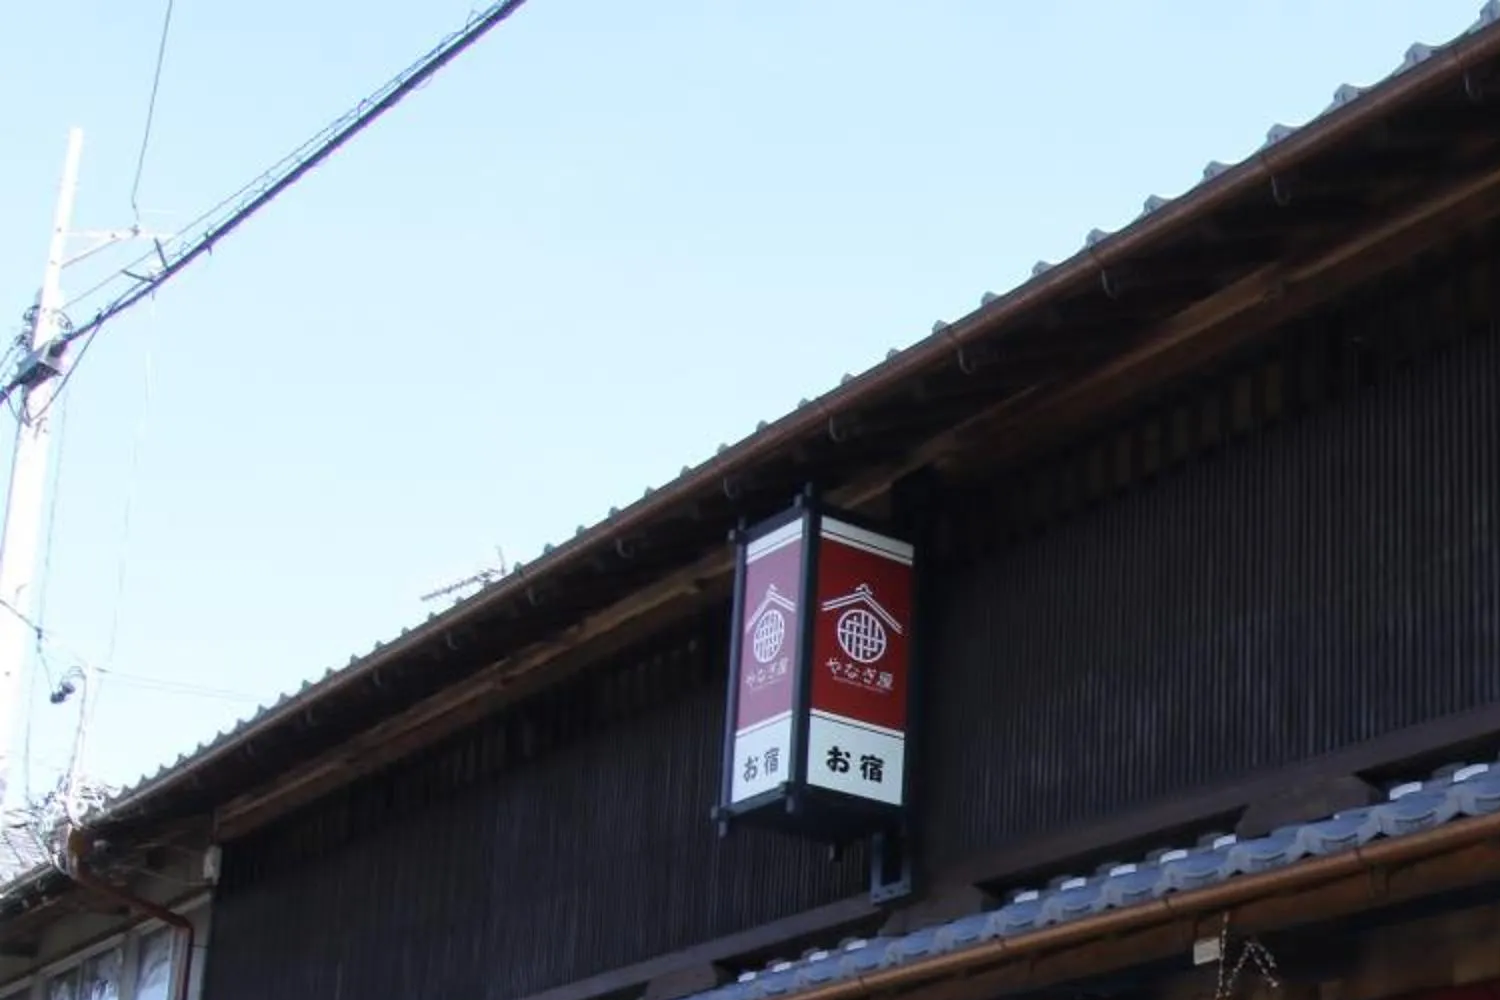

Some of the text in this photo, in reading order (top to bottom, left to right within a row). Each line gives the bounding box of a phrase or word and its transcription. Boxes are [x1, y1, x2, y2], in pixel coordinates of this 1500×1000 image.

[825, 656, 893, 689] やなぎ屋
[743, 747, 780, 783] お宿
[825, 745, 885, 784] お宿
